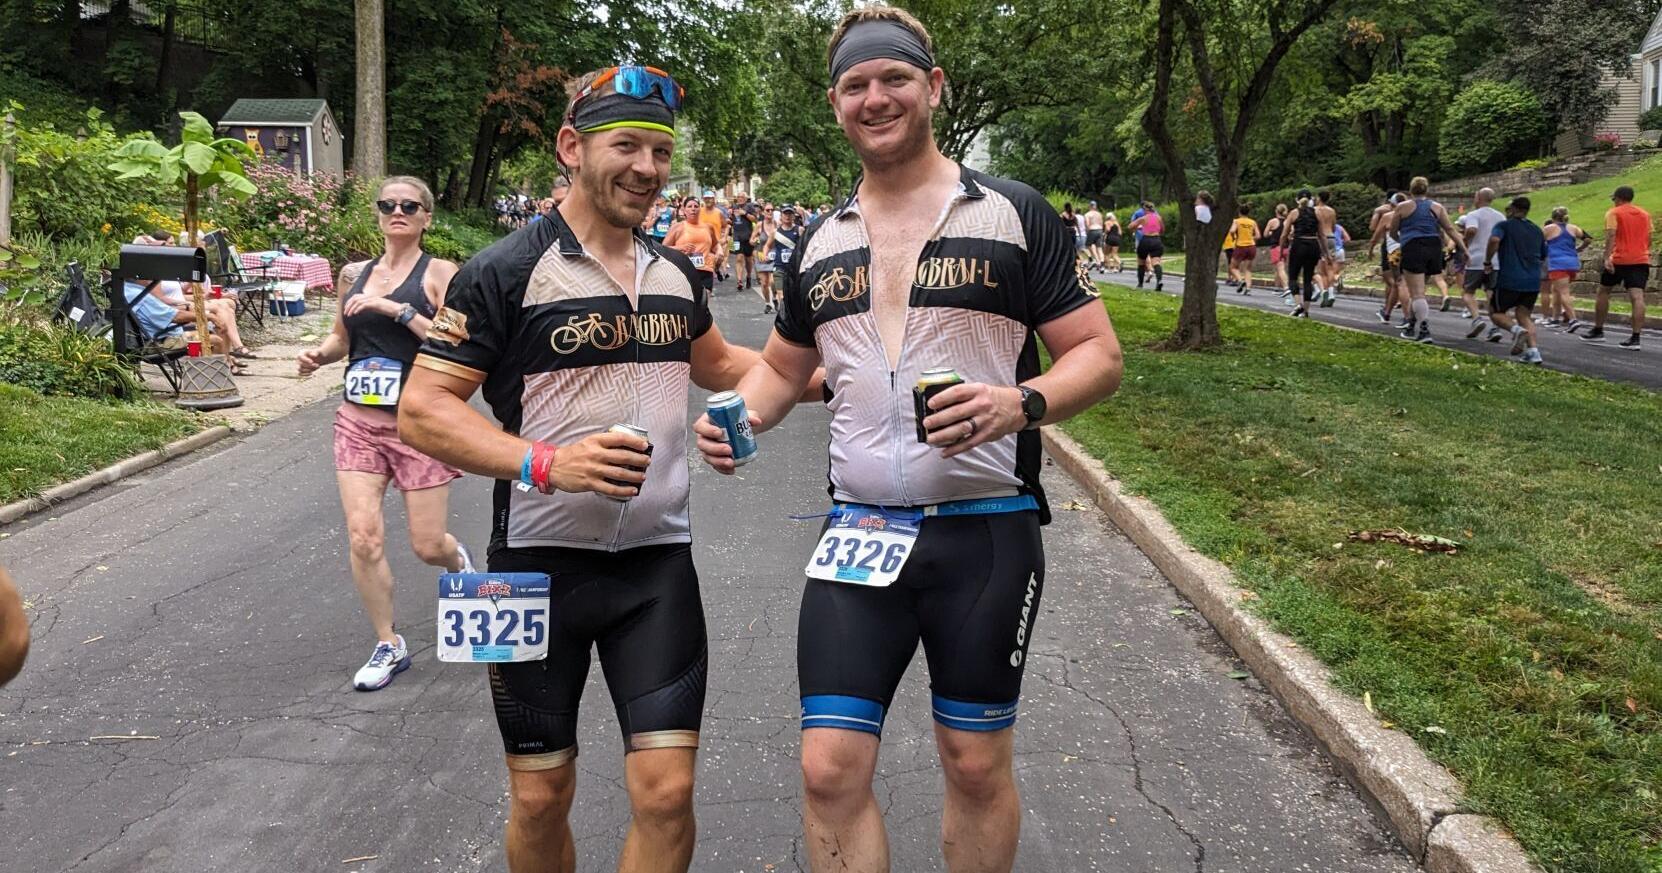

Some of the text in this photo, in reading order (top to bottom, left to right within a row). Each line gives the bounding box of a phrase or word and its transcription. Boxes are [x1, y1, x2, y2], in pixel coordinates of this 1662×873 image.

[349, 376, 398, 397] 2517
[816, 535, 907, 574] 3326
[443, 608, 545, 647] 3325
[1016, 571, 1038, 647] GIANT
